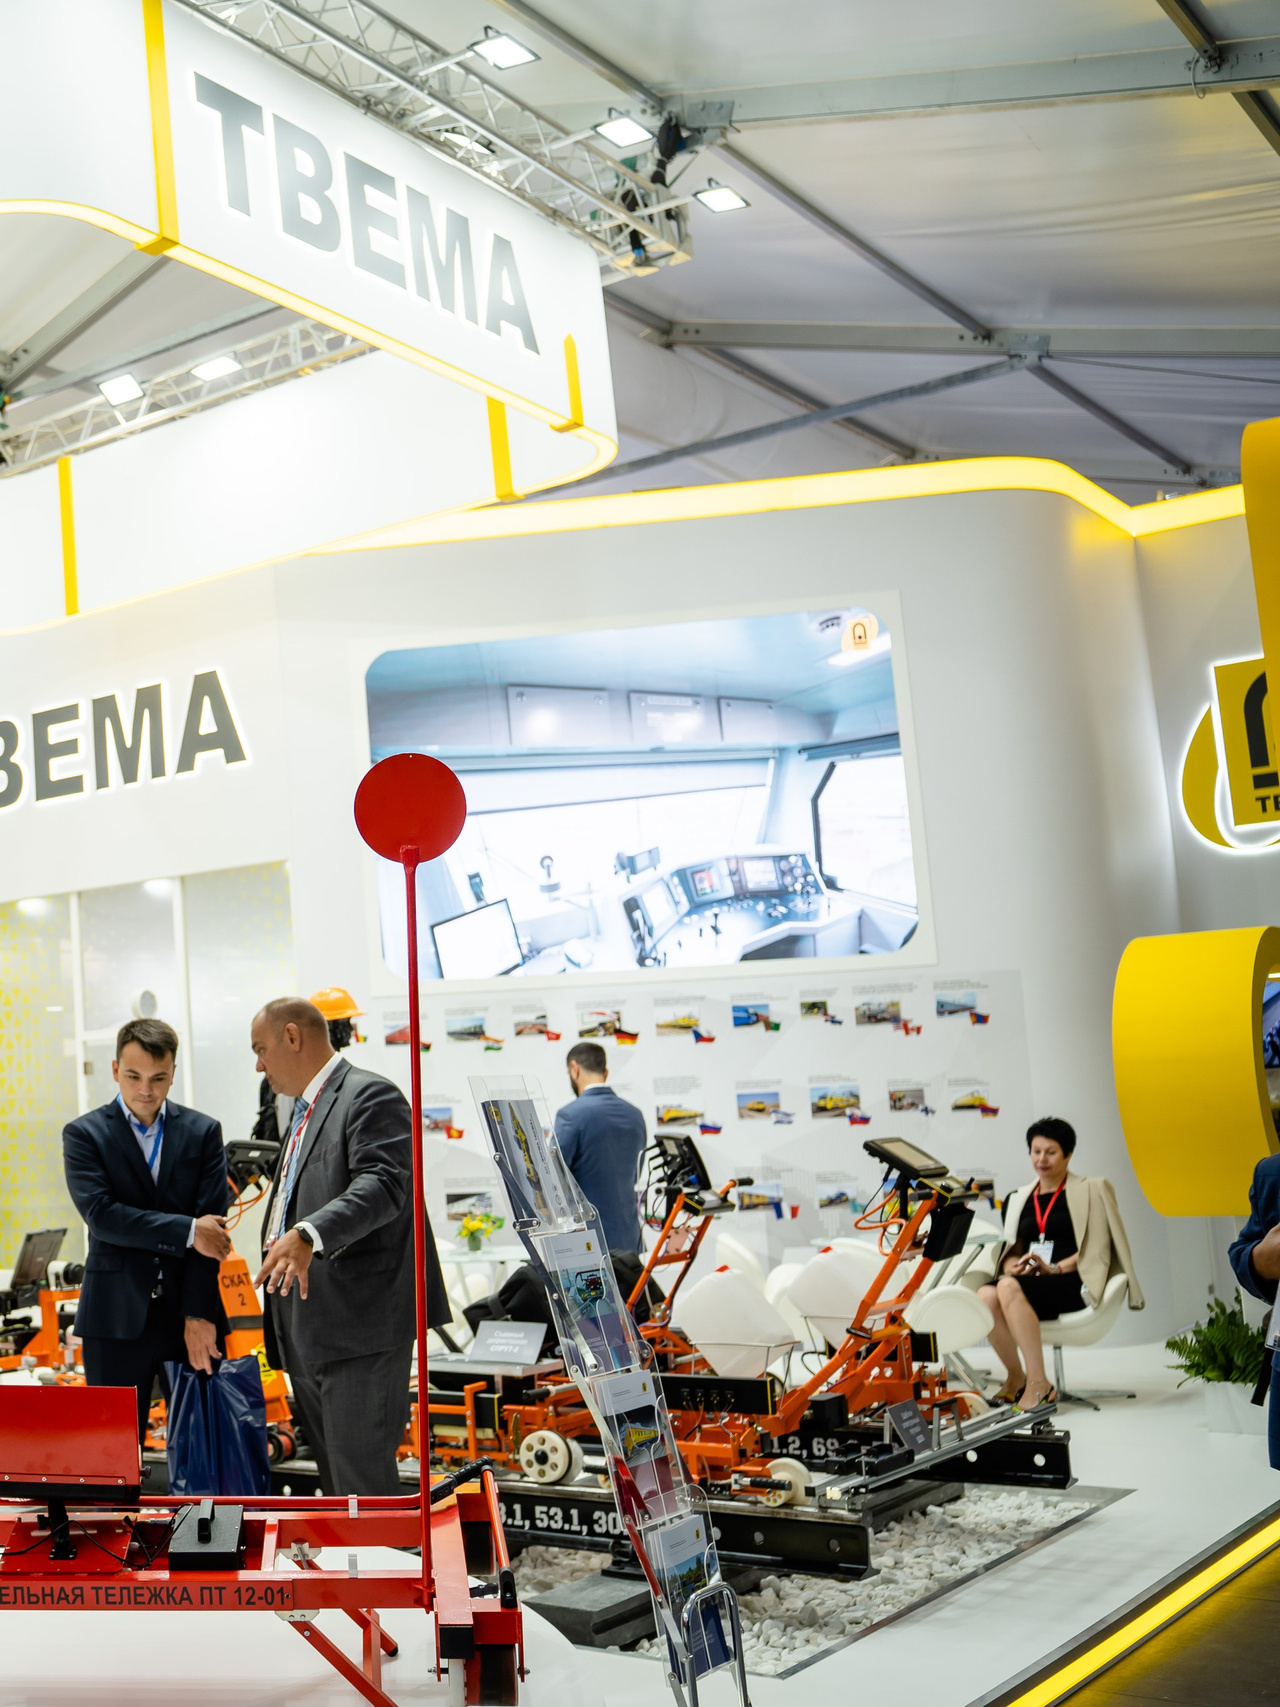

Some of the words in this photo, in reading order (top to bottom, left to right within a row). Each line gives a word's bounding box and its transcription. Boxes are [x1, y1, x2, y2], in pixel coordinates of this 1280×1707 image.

[194, 71, 540, 356] ТВЕМА
[221, 1273, 250, 1288] СКАТ
[238, 1293, 246, 1306] 2
[535, 1506, 588, 1536] 53.1,
[91, 1586, 193, 1605] ТЕЛЕЖКА
[200, 1586, 226, 1605] ПТ
[234, 1586, 285, 1606] 12-01
